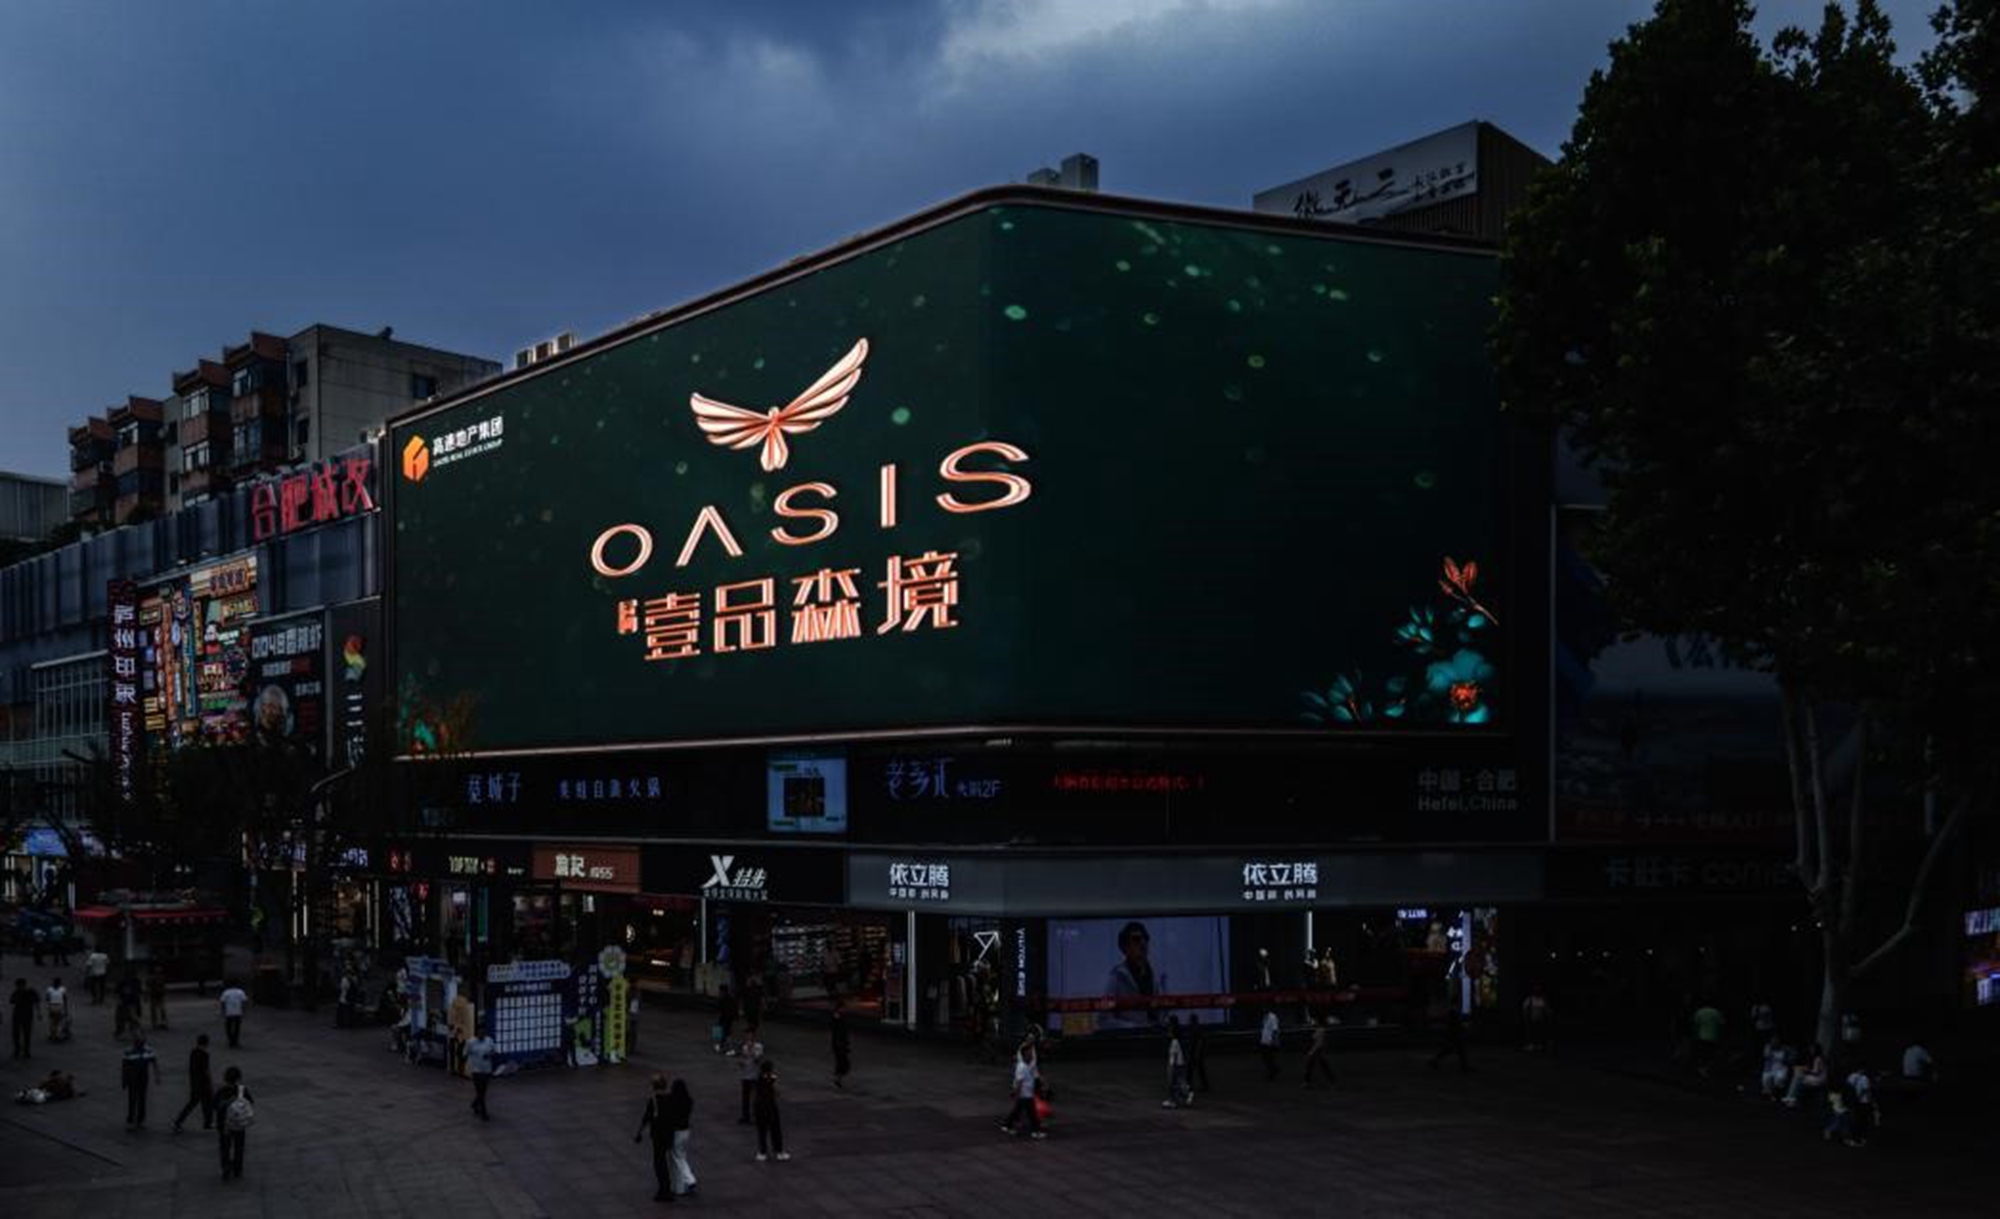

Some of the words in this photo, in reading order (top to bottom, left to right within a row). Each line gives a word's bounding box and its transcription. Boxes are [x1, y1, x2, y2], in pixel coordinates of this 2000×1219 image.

[433, 415, 504, 456] 高速地产集团
[589, 441, 1034, 578] OASIS
[643, 550, 960, 661] 壹品森境
[889, 863, 949, 887] 依立腾
[1243, 863, 1318, 885] 依立腾
